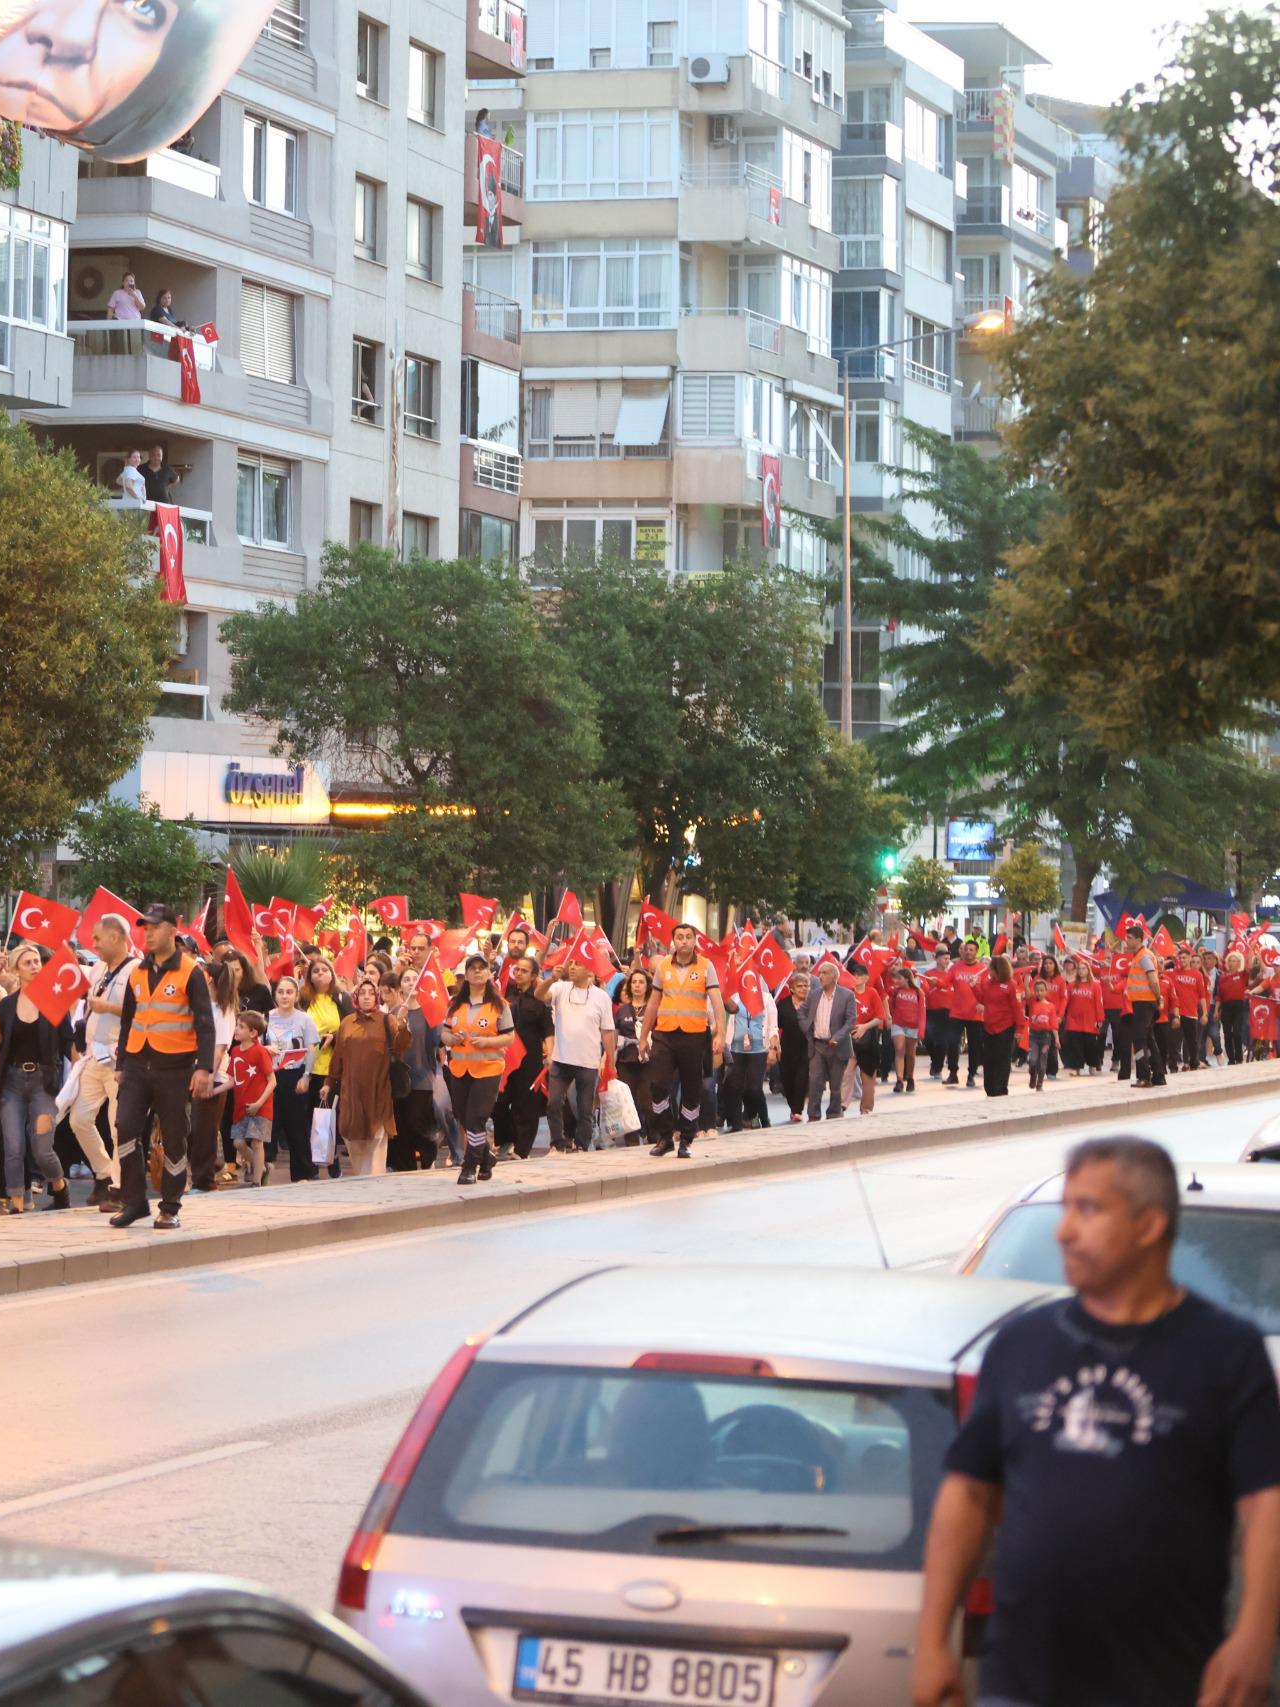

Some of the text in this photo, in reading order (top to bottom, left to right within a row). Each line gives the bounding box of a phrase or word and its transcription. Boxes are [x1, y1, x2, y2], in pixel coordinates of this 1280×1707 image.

[541, 1645, 762, 1702] 45 HB 8805
